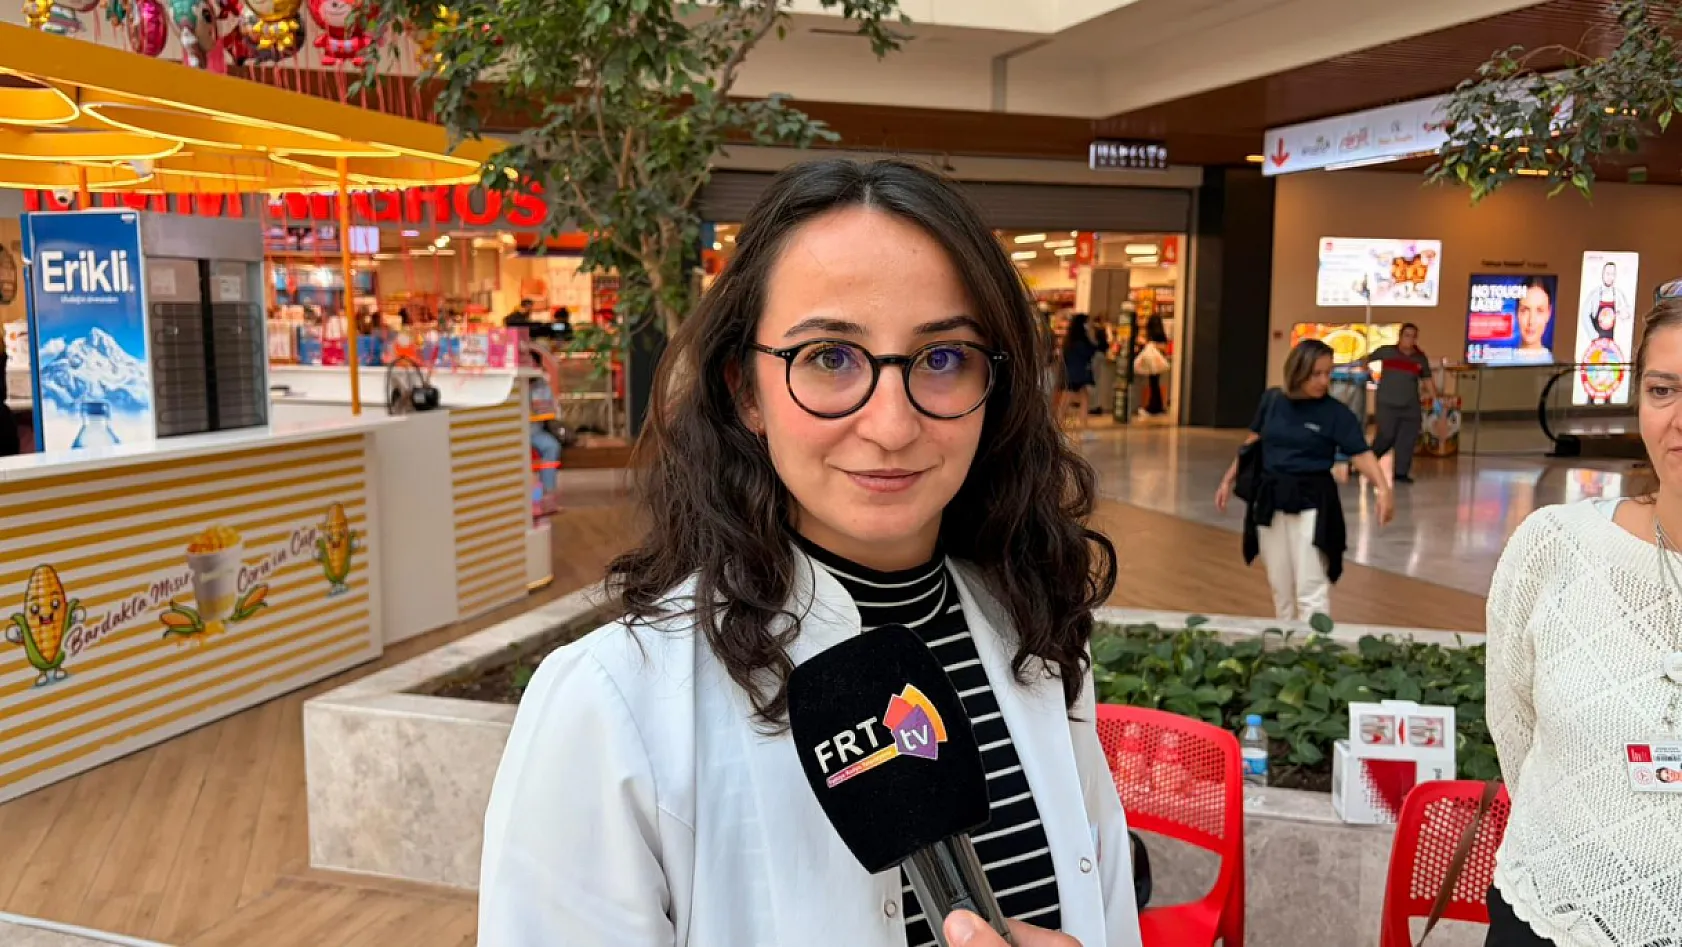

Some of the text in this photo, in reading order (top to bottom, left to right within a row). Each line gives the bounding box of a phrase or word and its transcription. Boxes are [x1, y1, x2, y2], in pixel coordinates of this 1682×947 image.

[41, 250, 128, 293] Erikli
[814, 716, 879, 774] FRT
[900, 724, 928, 751] tv
